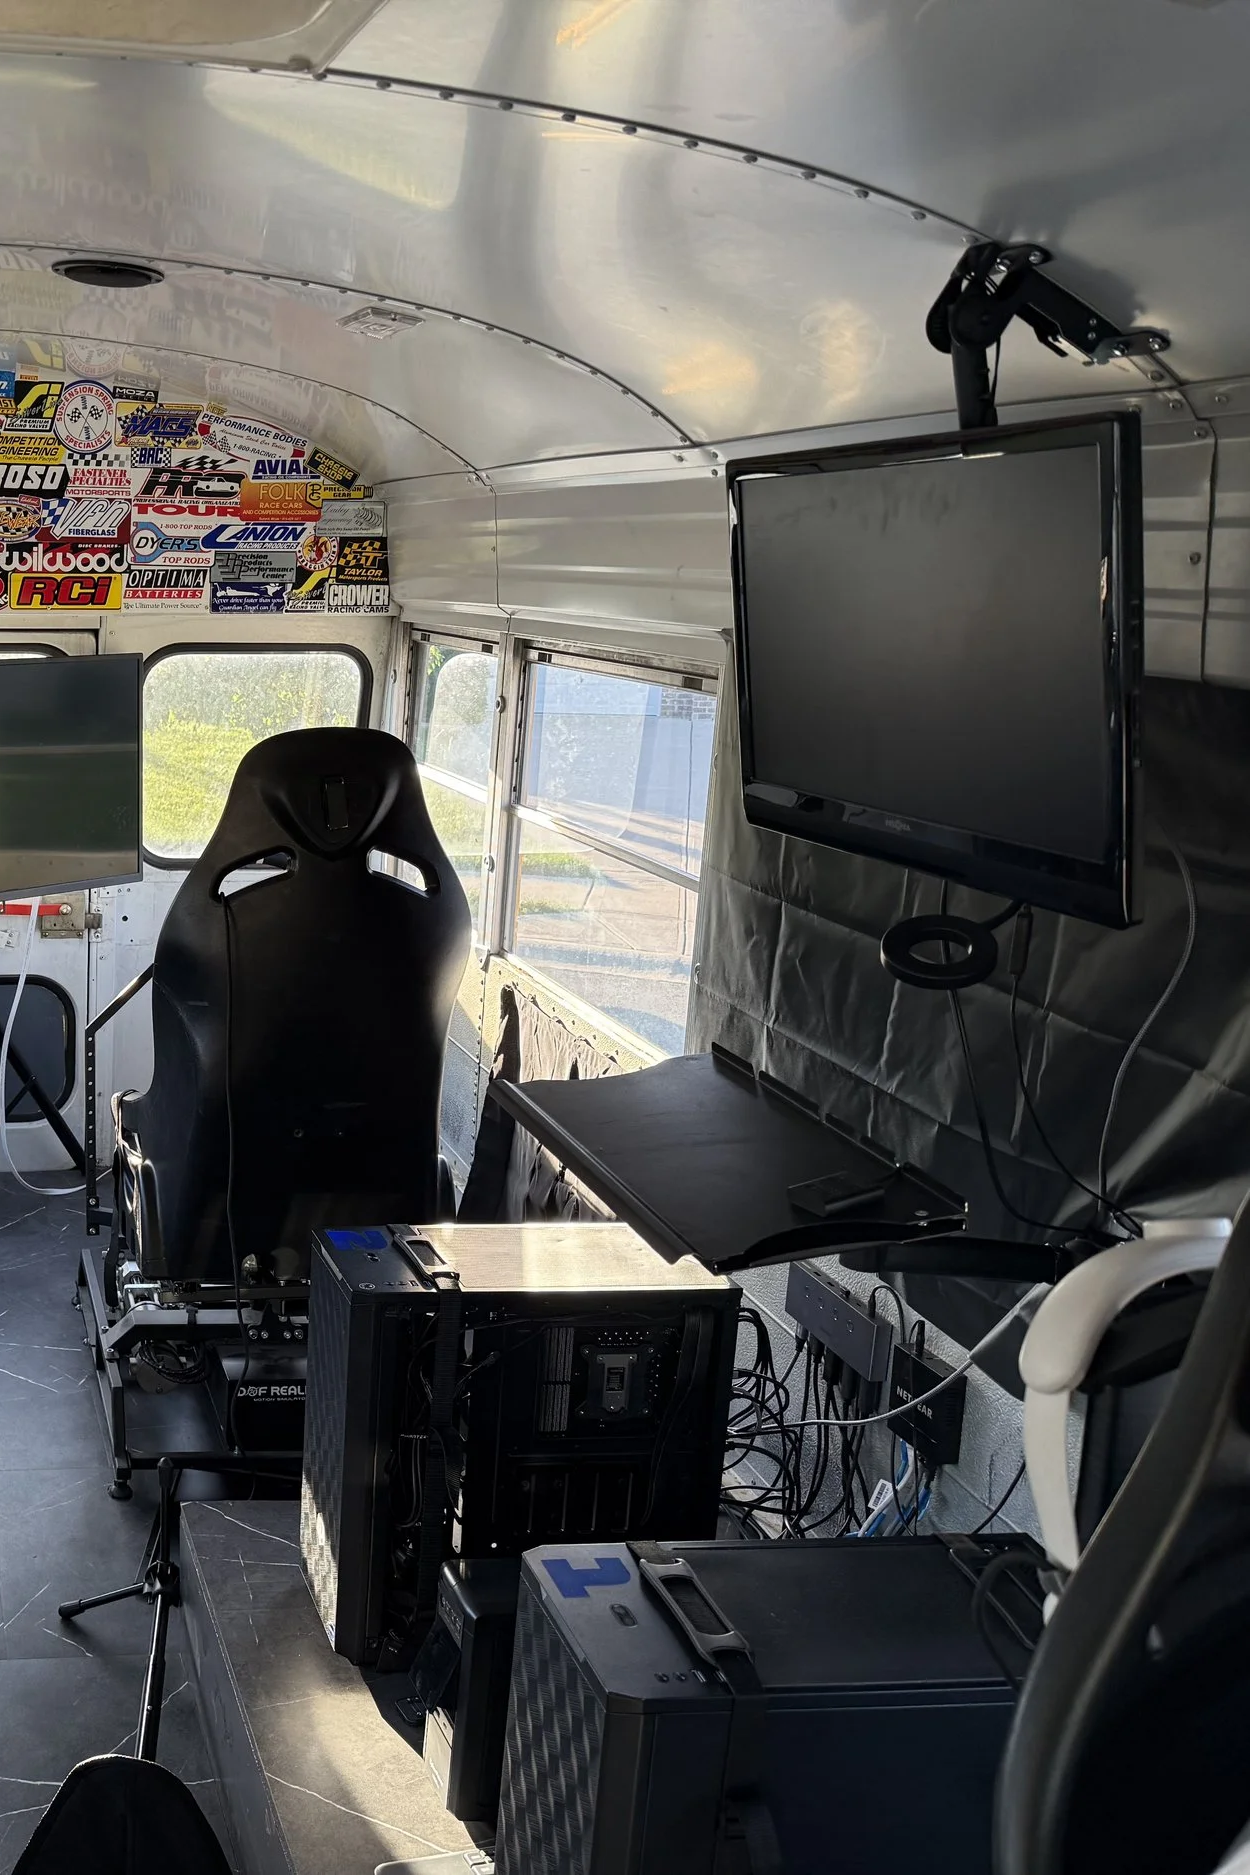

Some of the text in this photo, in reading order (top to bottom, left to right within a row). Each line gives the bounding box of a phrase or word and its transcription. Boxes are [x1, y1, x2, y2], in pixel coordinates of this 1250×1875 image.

[116, 388, 155, 397] MOZA
[95, 388, 114, 415] SPRING
[201, 413, 272, 439] PERFORMANCE
[272, 432, 308, 447] BODIES
[64, 430, 112, 449] SPECIALISTS
[233, 443, 277, 459] 1-800-RACING
[69, 476, 131, 486] SPECIALTIES
[73, 468, 127, 478] FASTENER
[66, 489, 131, 497] MOTORSPORTS
[259, 483, 306, 500] FOLK
[133, 504, 240, 518] TOUR
[0, 543, 128, 572] wilwood
[129, 569, 205, 588] OPTIMA
[344, 568, 383, 576] TAYLOR
[125, 590, 202, 598] BATTERIES
[329, 585, 389, 606] CROWER
[896, 1385, 933, 1419] NETEAR
